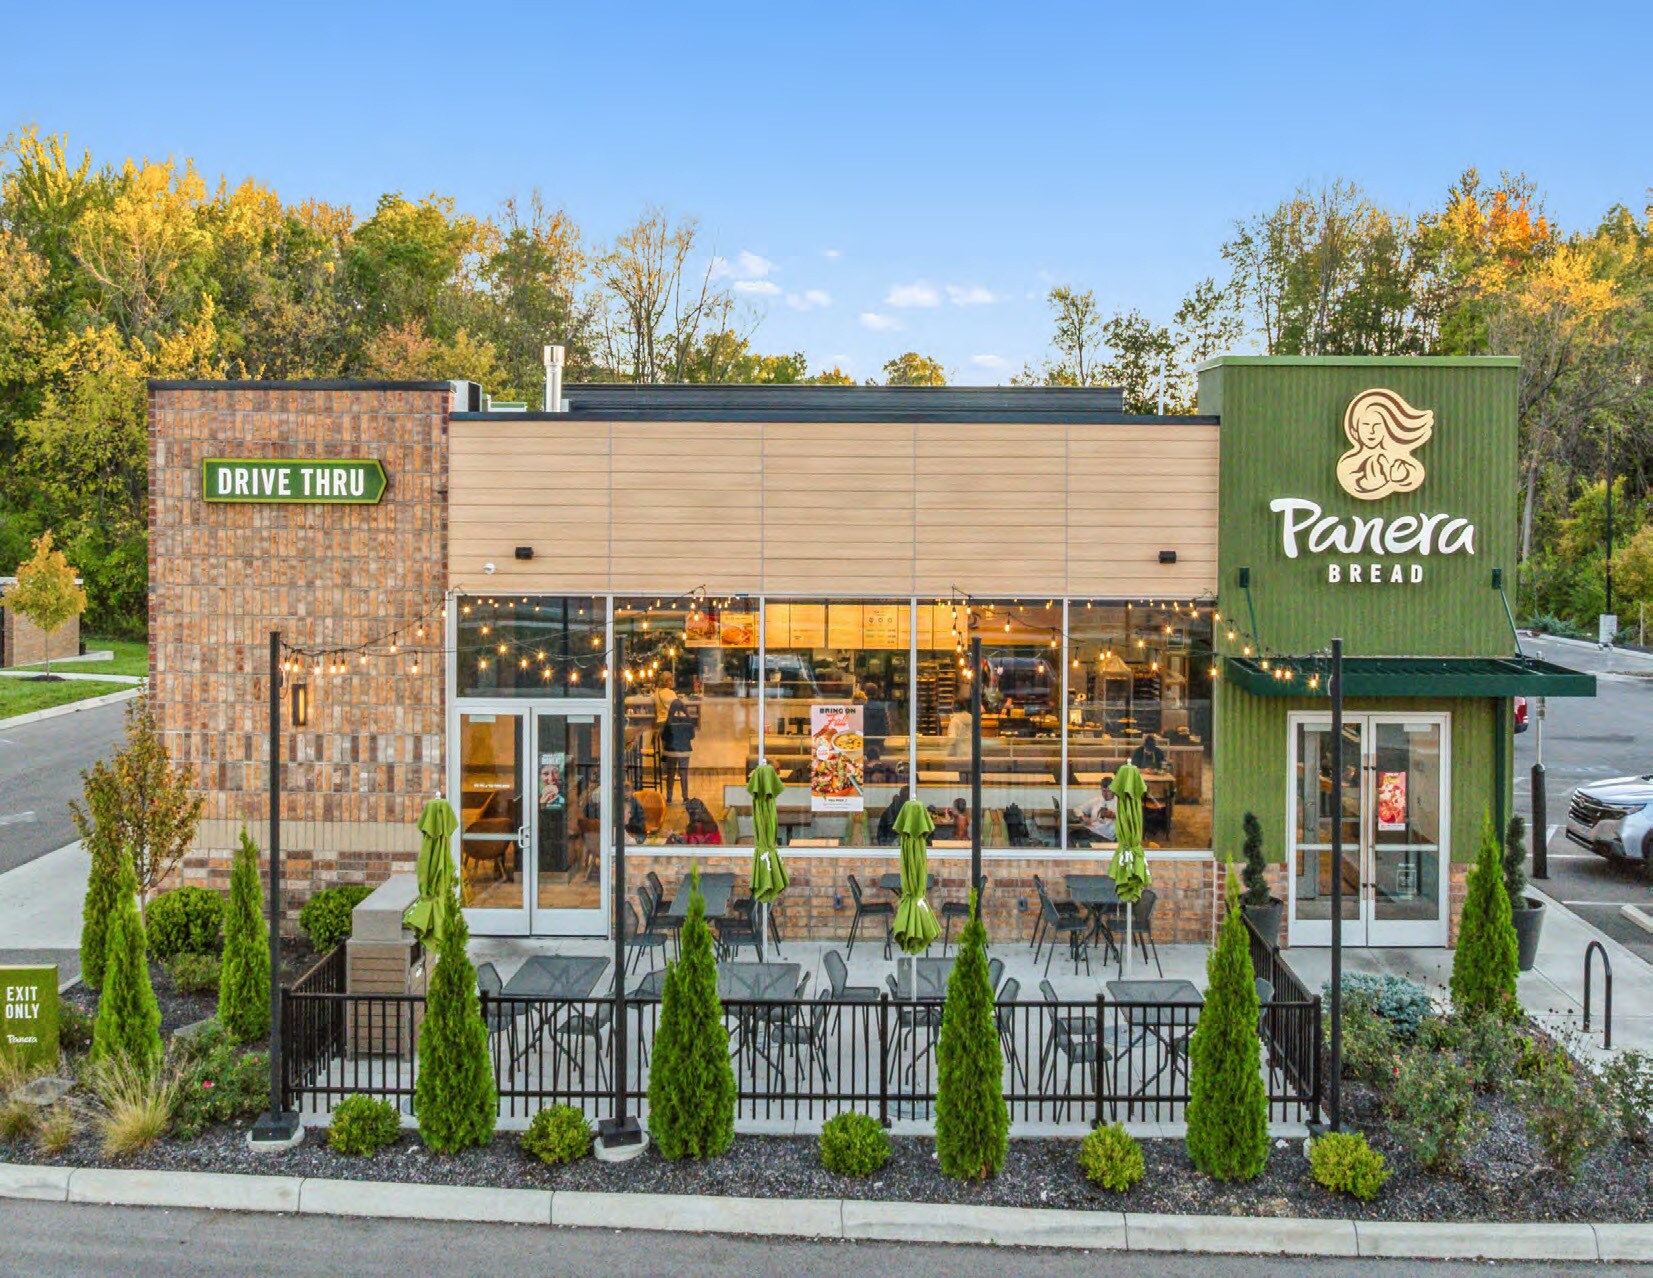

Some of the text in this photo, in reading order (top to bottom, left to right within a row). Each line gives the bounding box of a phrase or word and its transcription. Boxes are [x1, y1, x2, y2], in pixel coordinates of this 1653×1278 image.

[218, 467, 364, 496] DRIVE THRU
[1270, 498, 1475, 558] Panera
[1328, 563, 1424, 583] BREAD
[6, 986, 38, 1002] EXIT
[5, 1003, 40, 1019] ONLY
[7, 1034, 38, 1044] Panera
